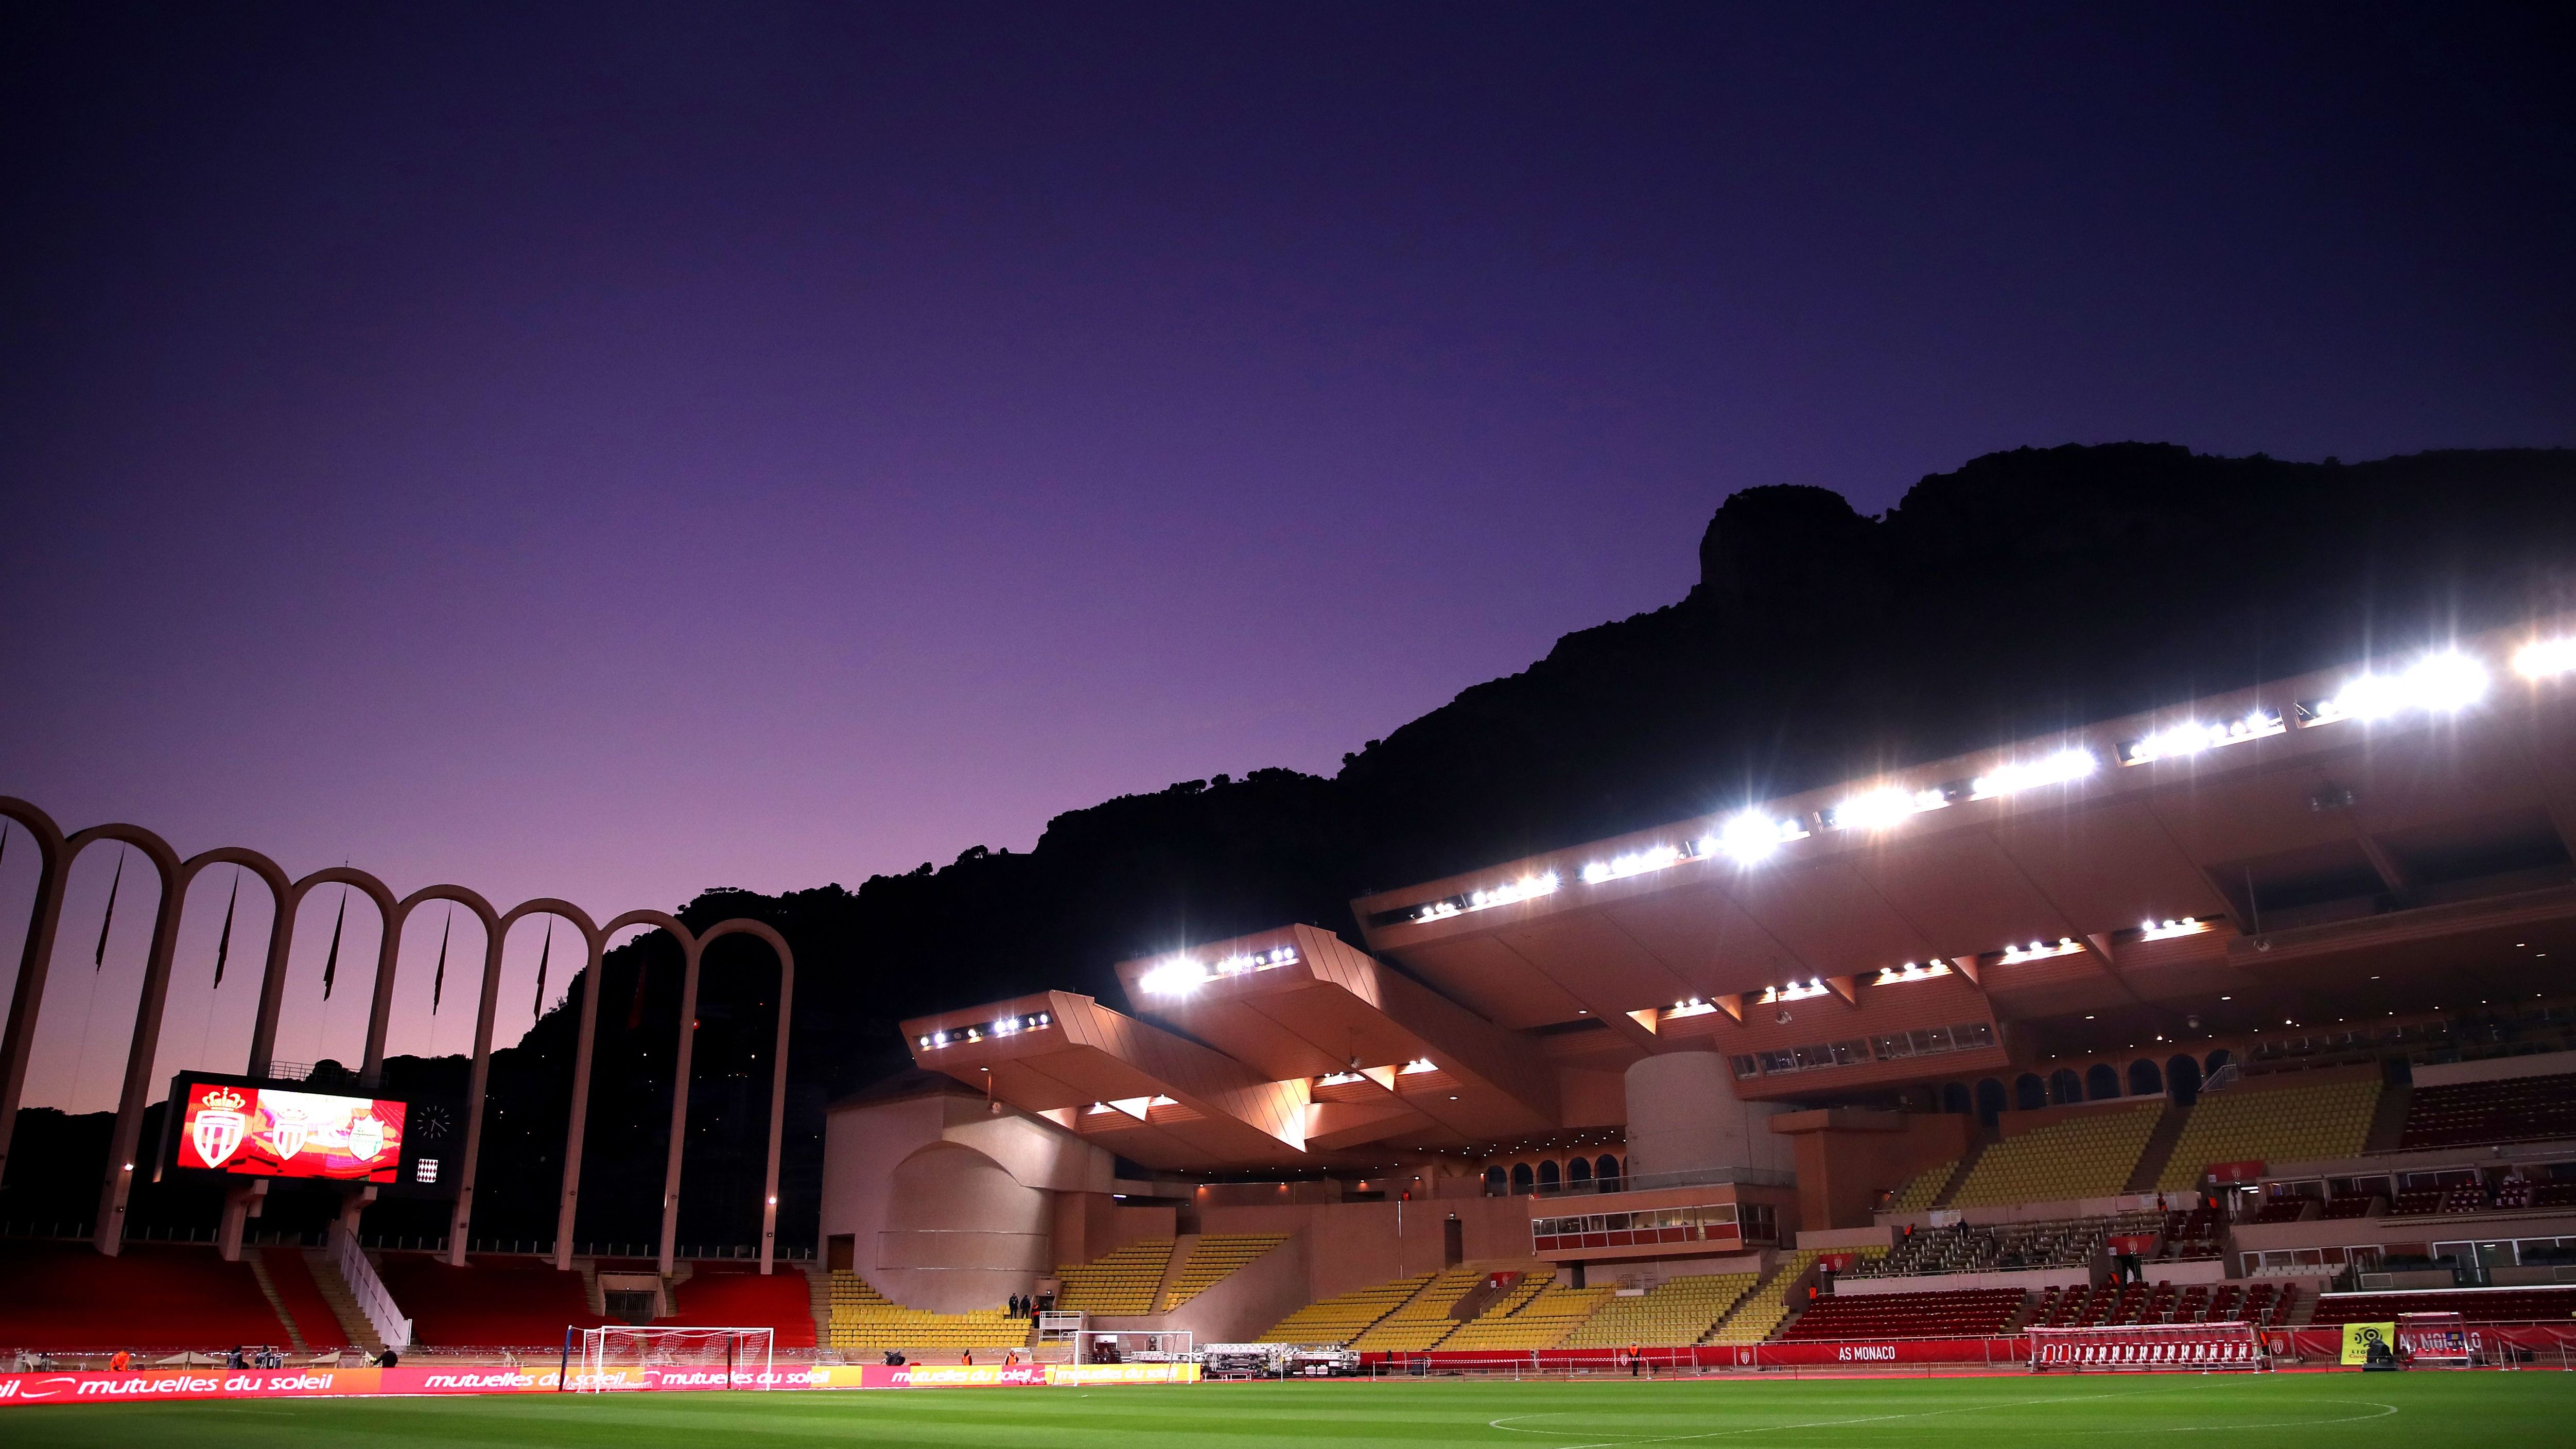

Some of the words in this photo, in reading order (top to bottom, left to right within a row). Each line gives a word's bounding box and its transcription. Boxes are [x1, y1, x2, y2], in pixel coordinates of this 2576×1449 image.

[1839, 1347, 1852, 1360] AS
[1854, 1346, 1895, 1360] MONACO
[425, 1373, 535, 1387] mutuelles
[786, 1370, 830, 1384] soleil
[892, 1369, 968, 1382] mutuelles
[970, 1369, 993, 1382] du
[996, 1369, 1032, 1381] soleil
[78, 1376, 219, 1394] mutuelles
[225, 1375, 260, 1390] du
[268, 1374, 333, 1390] soleil
